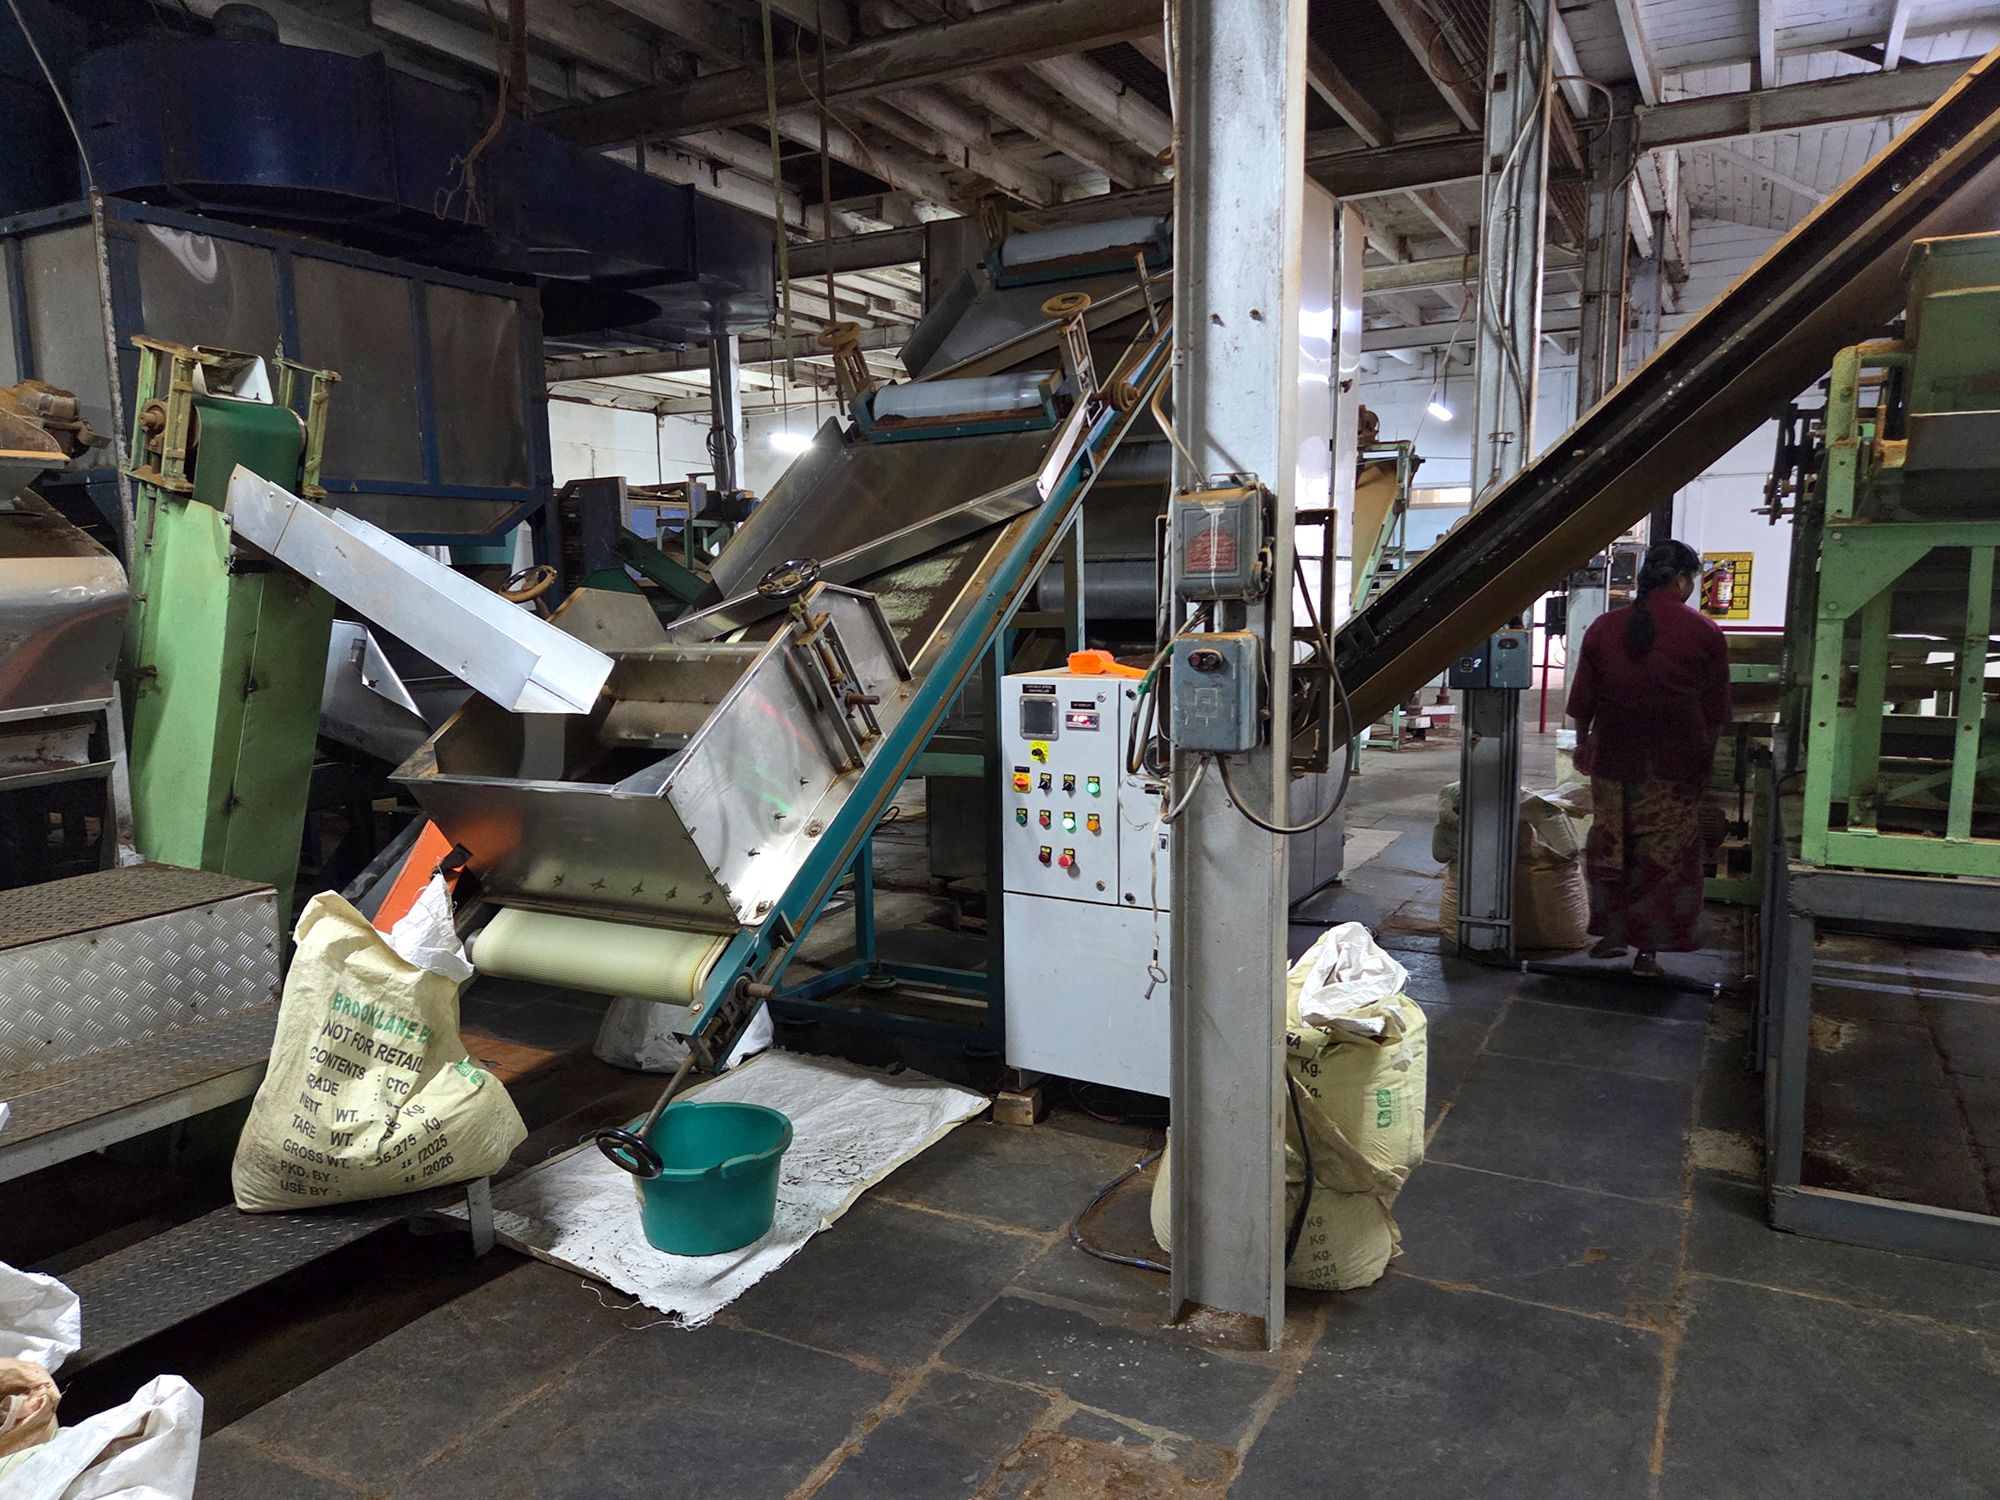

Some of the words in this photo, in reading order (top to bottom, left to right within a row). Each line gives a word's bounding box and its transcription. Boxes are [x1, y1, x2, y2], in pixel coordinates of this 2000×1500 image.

[331, 992, 419, 1040] BROOKLANE
[322, 1020, 352, 1043] NOT
[350, 1032, 375, 1056] FOR
[374, 1044, 424, 1073] RETAIL
[310, 1046, 366, 1080] CONTENTS
[386, 1077, 410, 1095] CTC
[1300, 1060, 1322, 1077] Kg.
[306, 1073, 339, 1096] RADE
[336, 1108, 359, 1122] WT.
[402, 1104, 426, 1118] Kg.
[283, 1138, 323, 1164] GROSS
[326, 1155, 350, 1169] WT.
[421, 1116, 443, 1134] Kg.
[292, 1113, 317, 1139] TARE
[330, 1131, 354, 1147] WT.
[280, 1159, 309, 1178] PKD.
[312, 1170, 331, 1182] BY
[280, 1180, 306, 1195] USE
[309, 1186, 329, 1197] BY
